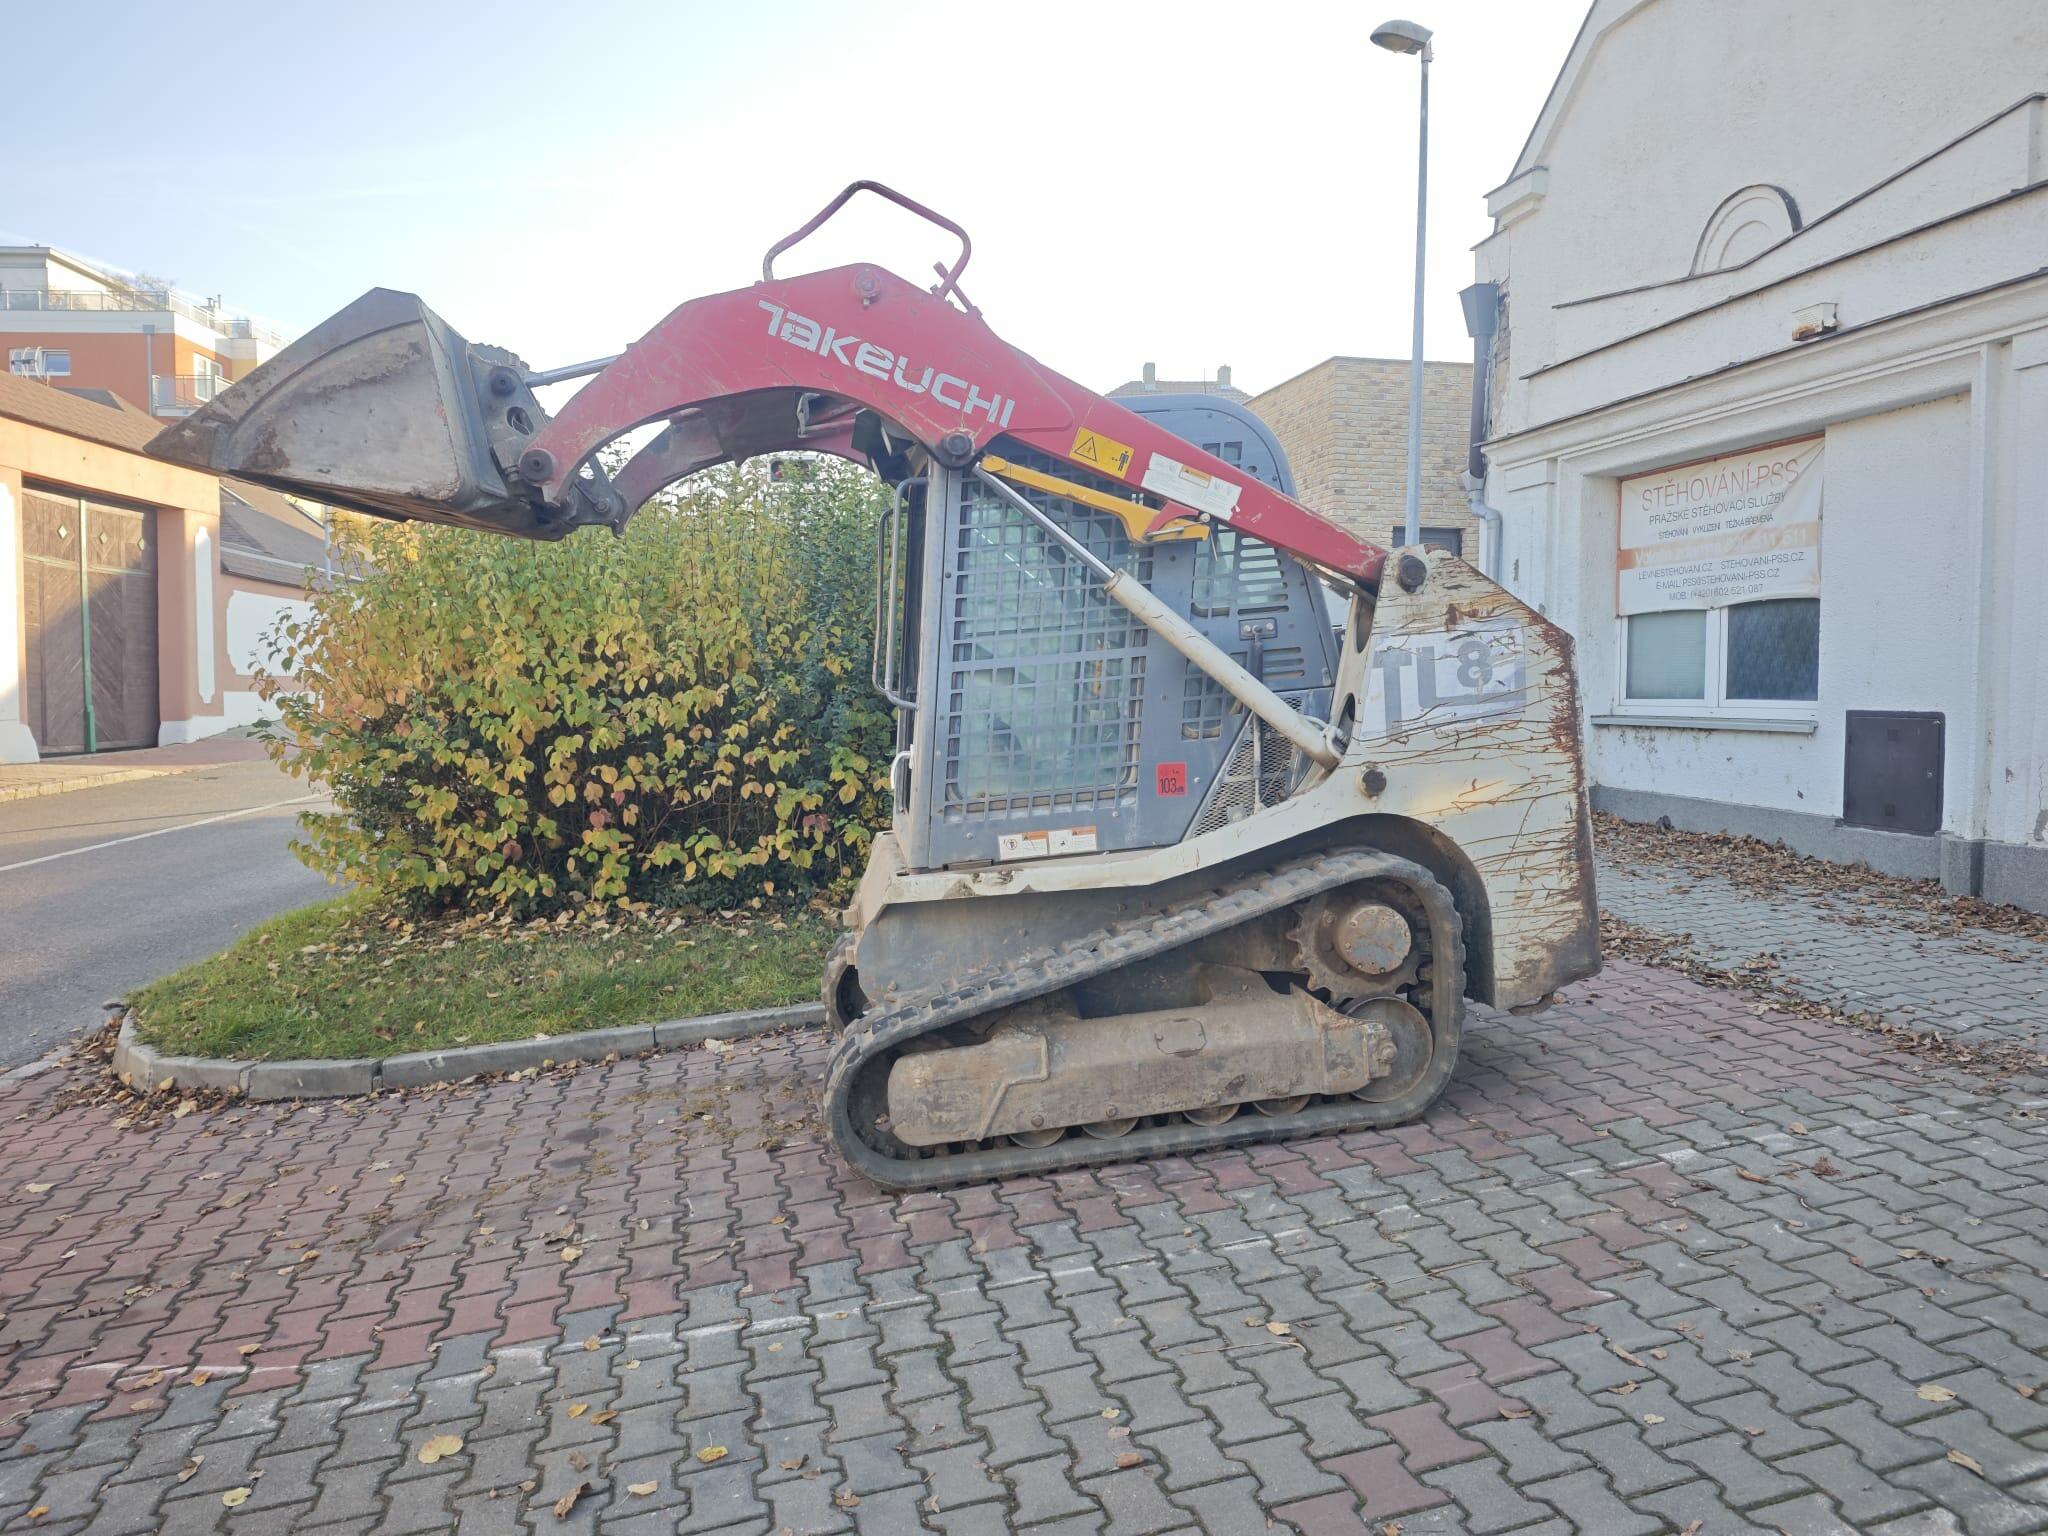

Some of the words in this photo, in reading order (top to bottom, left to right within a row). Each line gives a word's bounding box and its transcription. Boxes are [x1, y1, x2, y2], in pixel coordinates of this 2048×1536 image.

[1642, 458, 1799, 511] STĚHOVÁNÍ-PSS
[1749, 491, 1786, 509] SLUŽBY
[1159, 777, 1177, 793] 103
